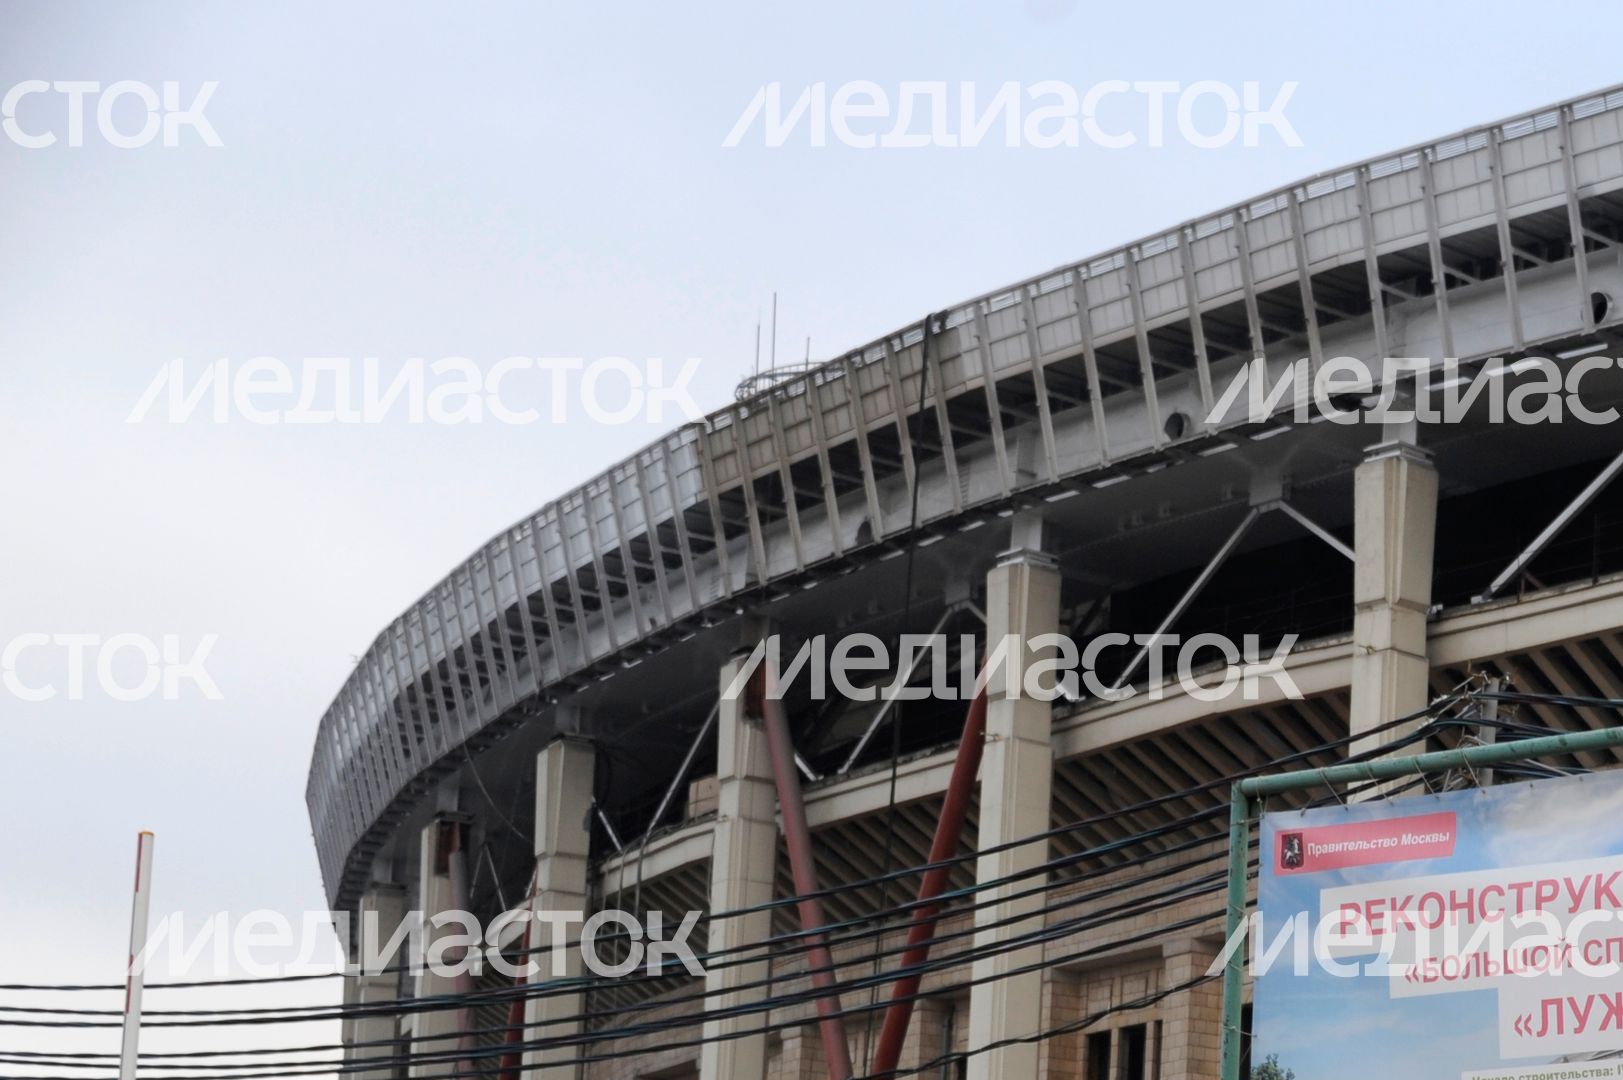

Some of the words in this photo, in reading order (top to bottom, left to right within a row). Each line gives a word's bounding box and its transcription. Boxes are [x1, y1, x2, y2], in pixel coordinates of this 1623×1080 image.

[1308, 836, 1398, 857] Правительство
[1401, 830, 1450, 847] Москвы
[1404, 937, 1573, 984] «БОЛЬШОЙ
